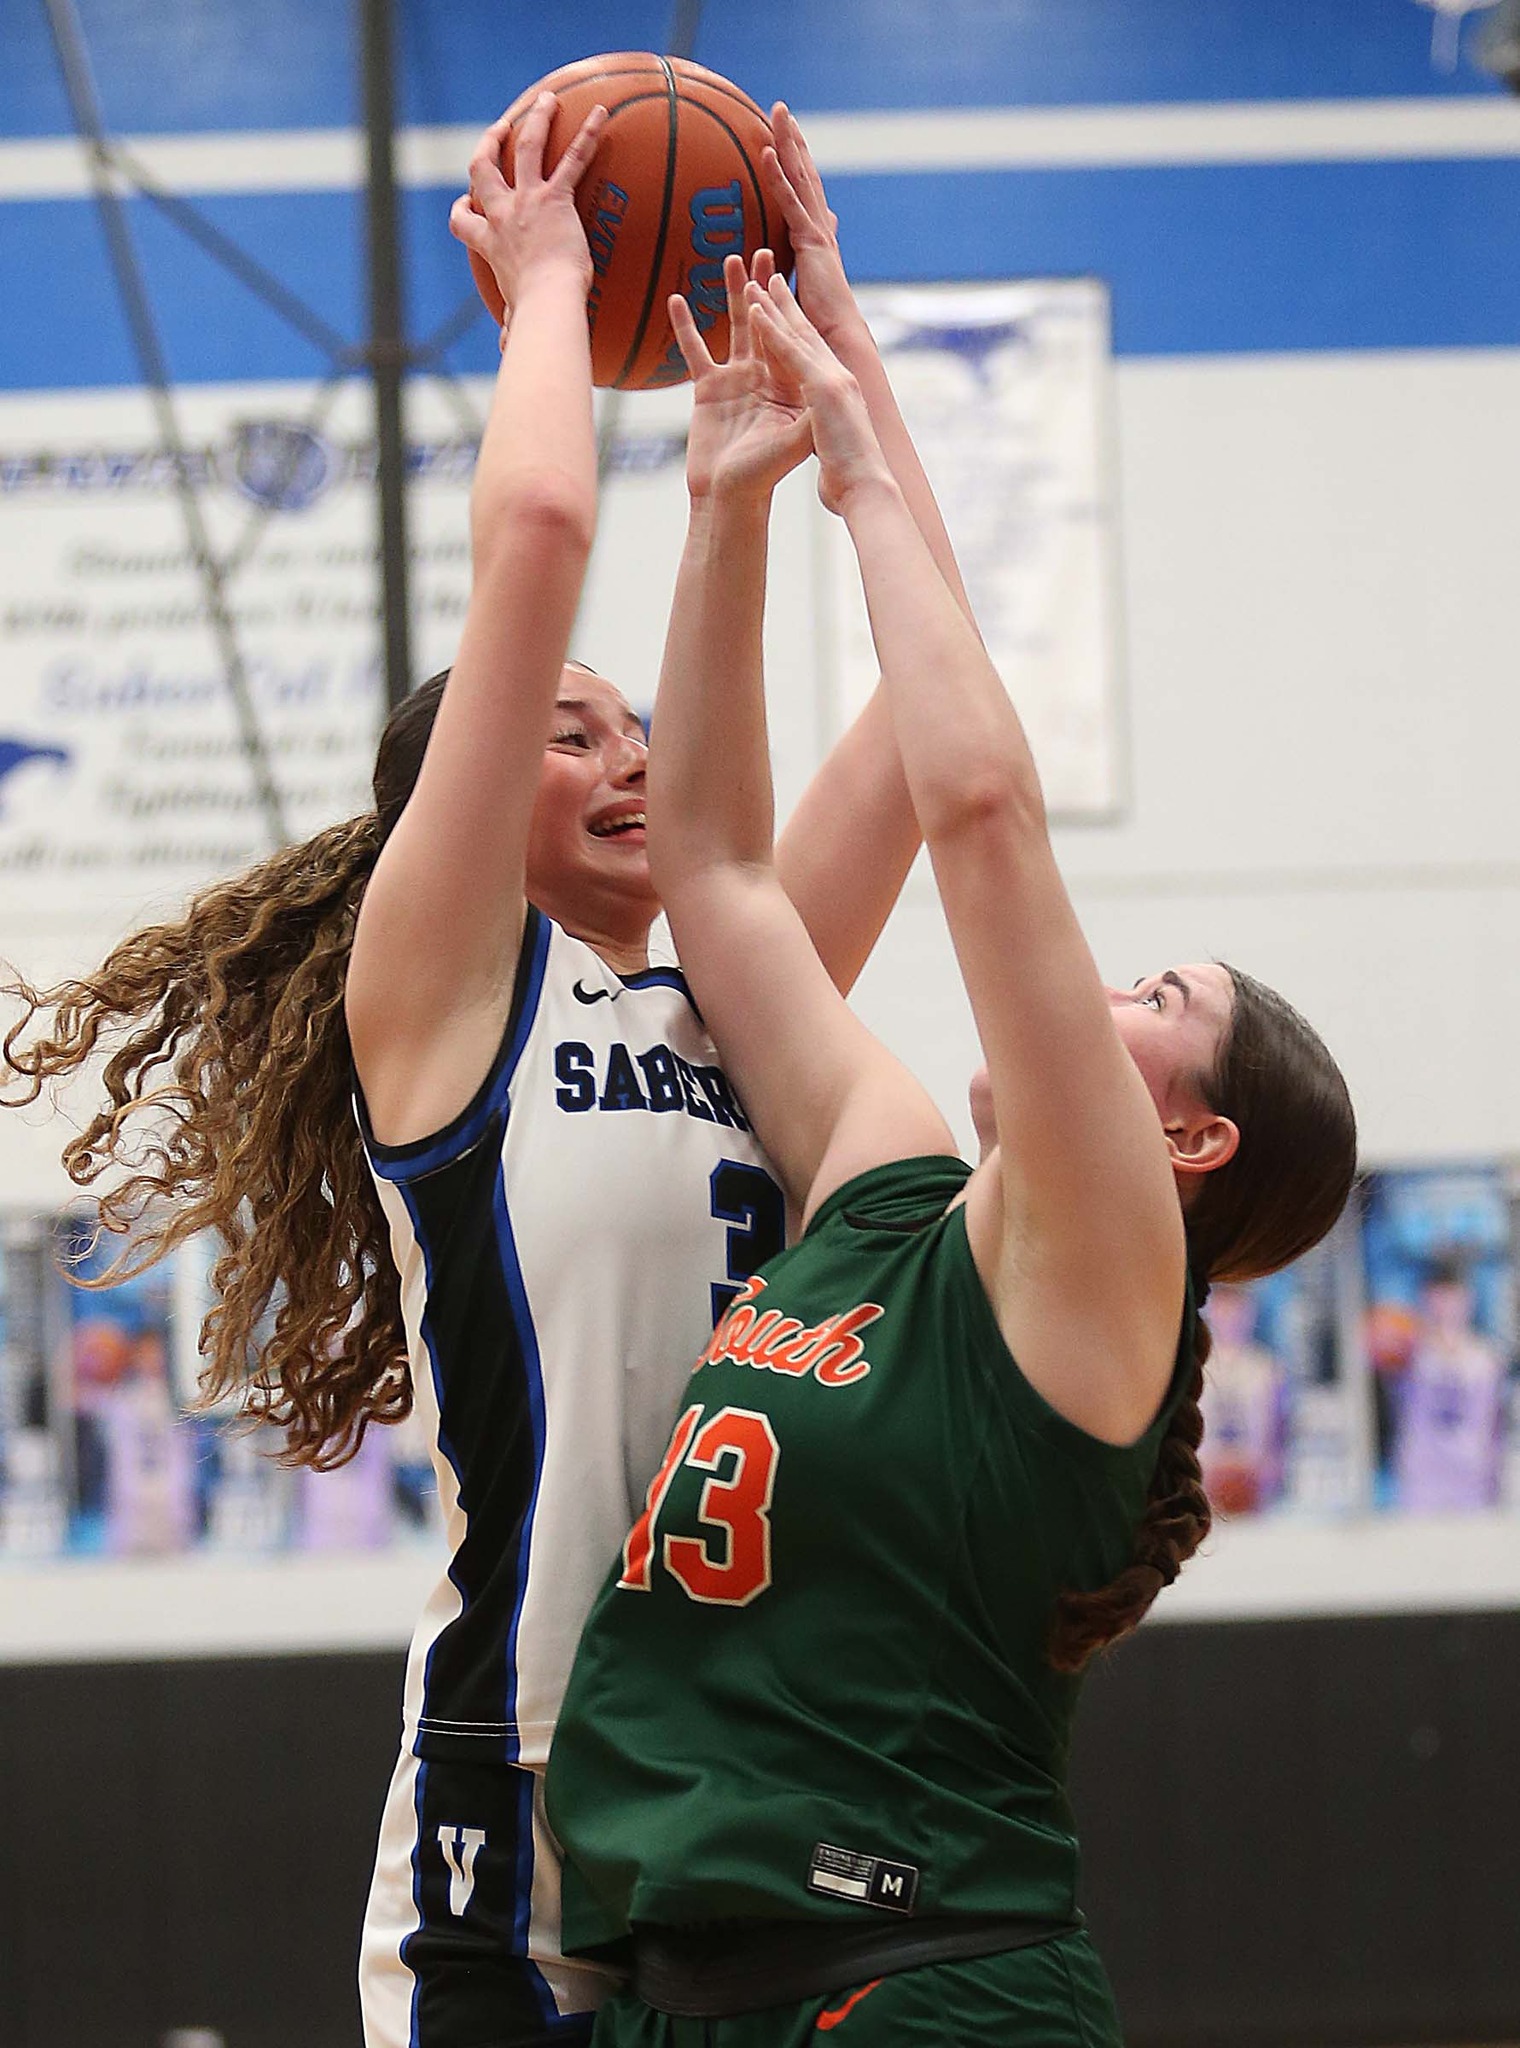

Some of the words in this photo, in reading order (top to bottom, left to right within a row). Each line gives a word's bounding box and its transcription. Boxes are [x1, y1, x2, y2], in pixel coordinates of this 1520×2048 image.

[554, 1041, 755, 1133] SABER
[616, 1403, 782, 1607] 13
[436, 1824, 487, 1917] V
[880, 1872, 904, 1898] M
